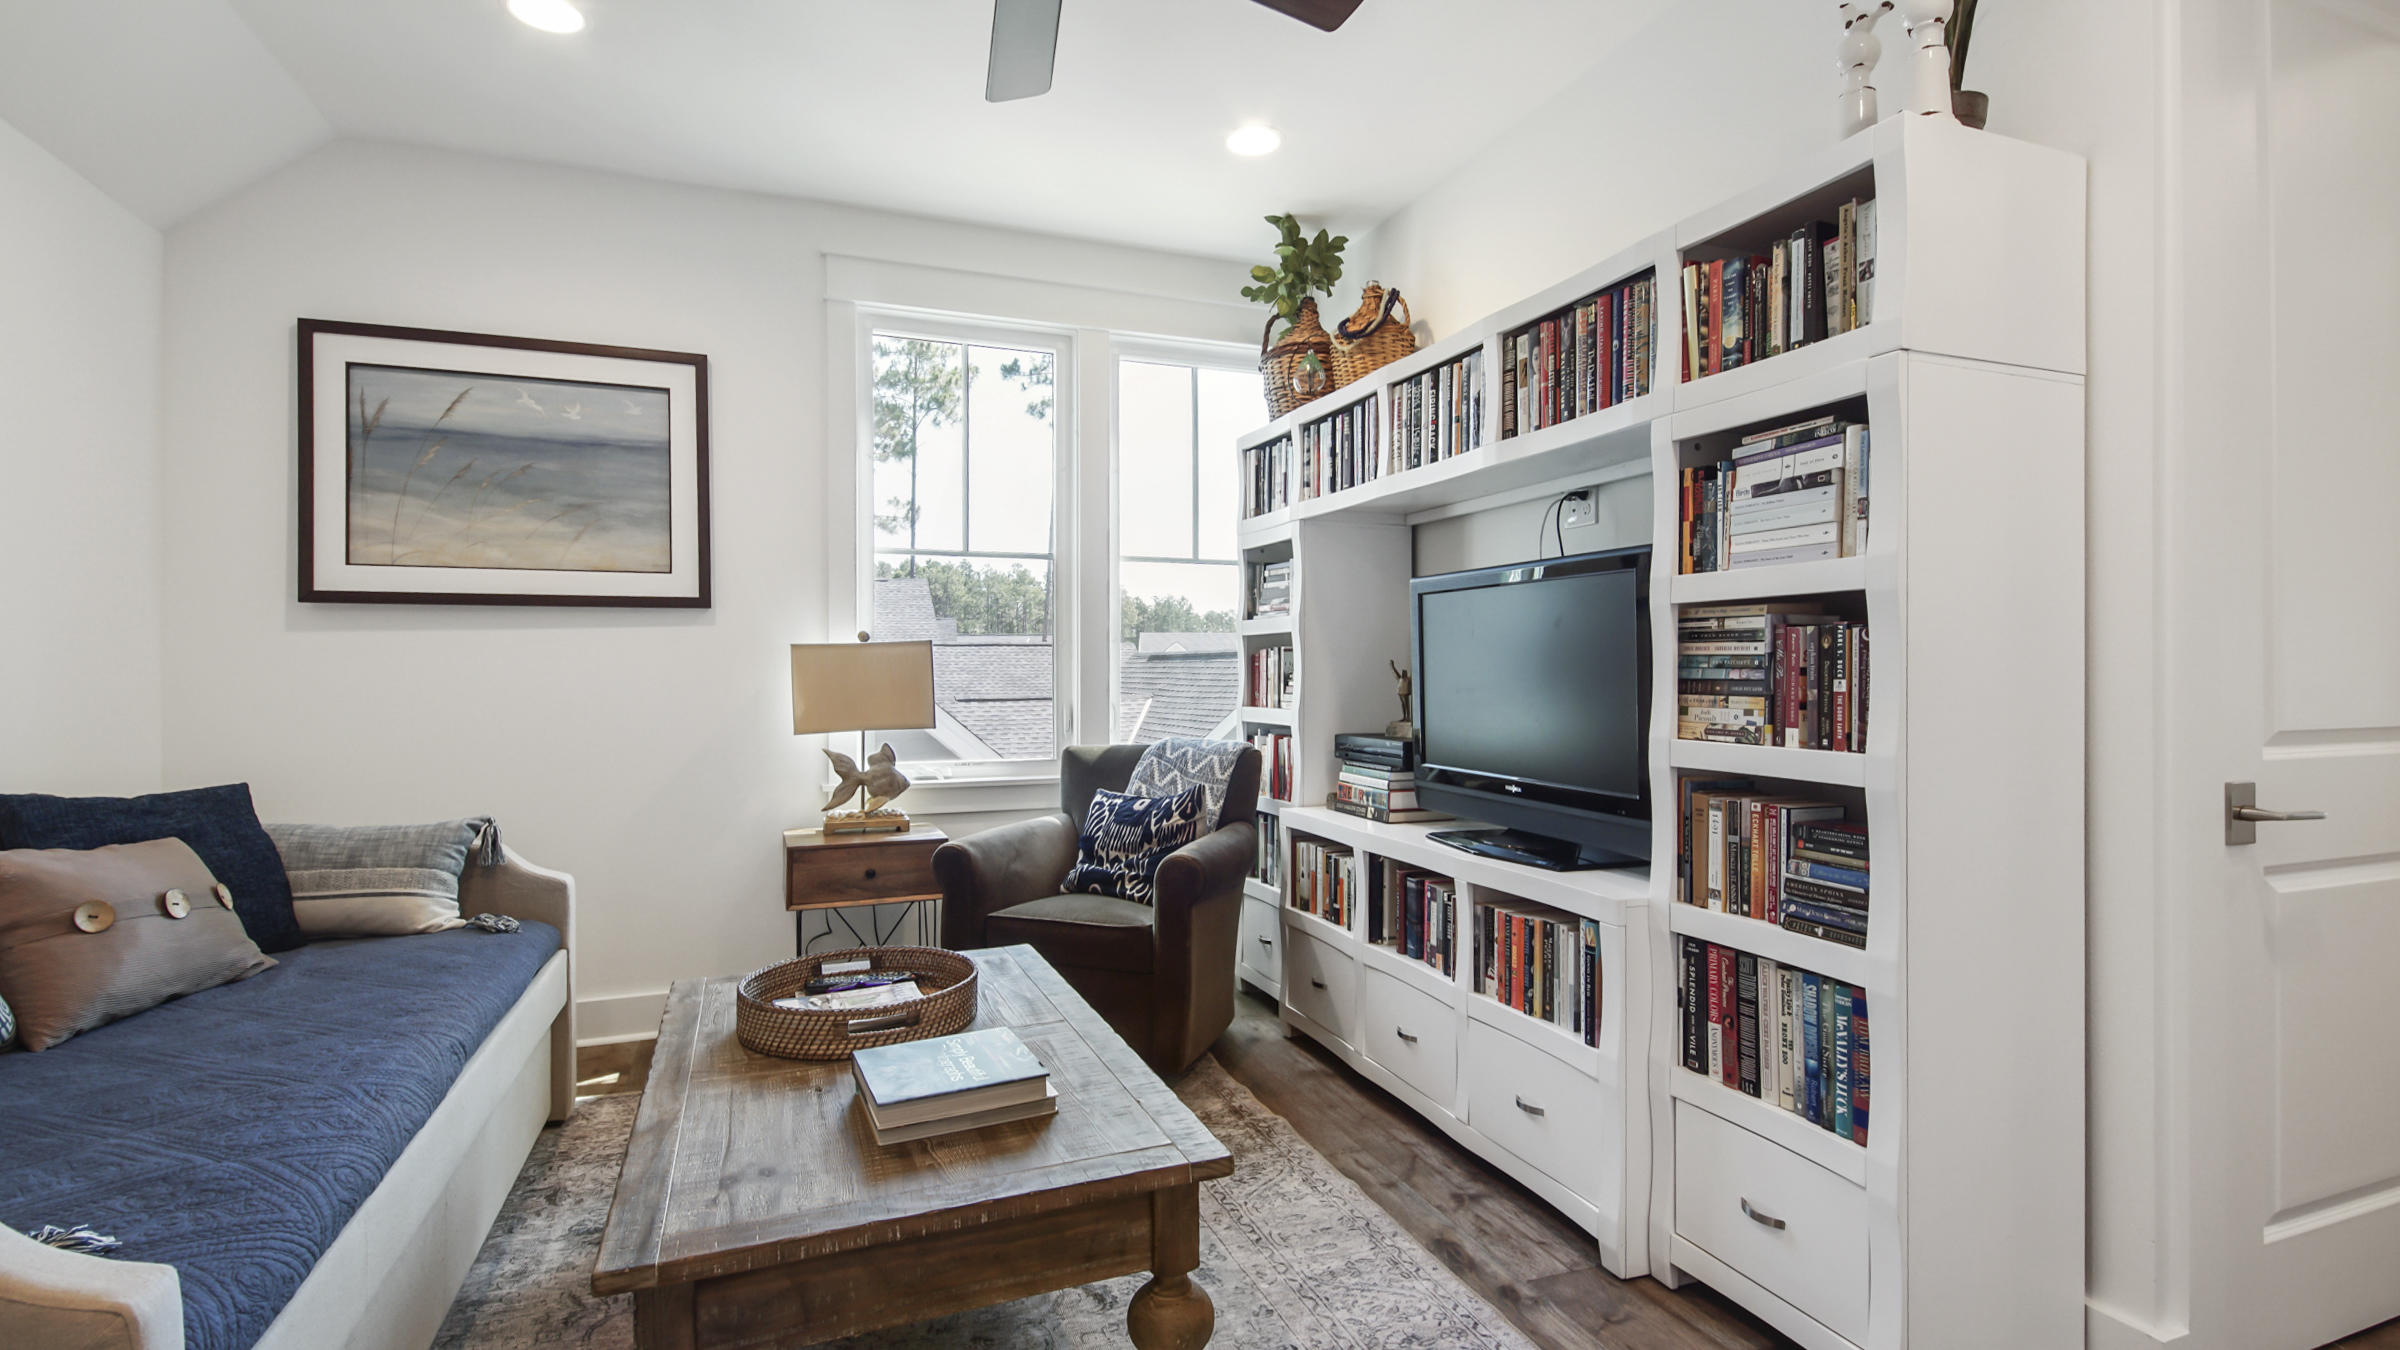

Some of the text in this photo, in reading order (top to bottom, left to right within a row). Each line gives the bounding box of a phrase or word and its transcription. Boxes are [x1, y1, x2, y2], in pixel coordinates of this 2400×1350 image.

[1710, 948, 1720, 1022] PRIMARY COLORS
[1803, 984, 1817, 1024] SHADOW
[1836, 1014, 1848, 1082] McNALLY'S
[1859, 1048, 1870, 1098] BROKAW
[1837, 1083, 1848, 1118] LUCK
